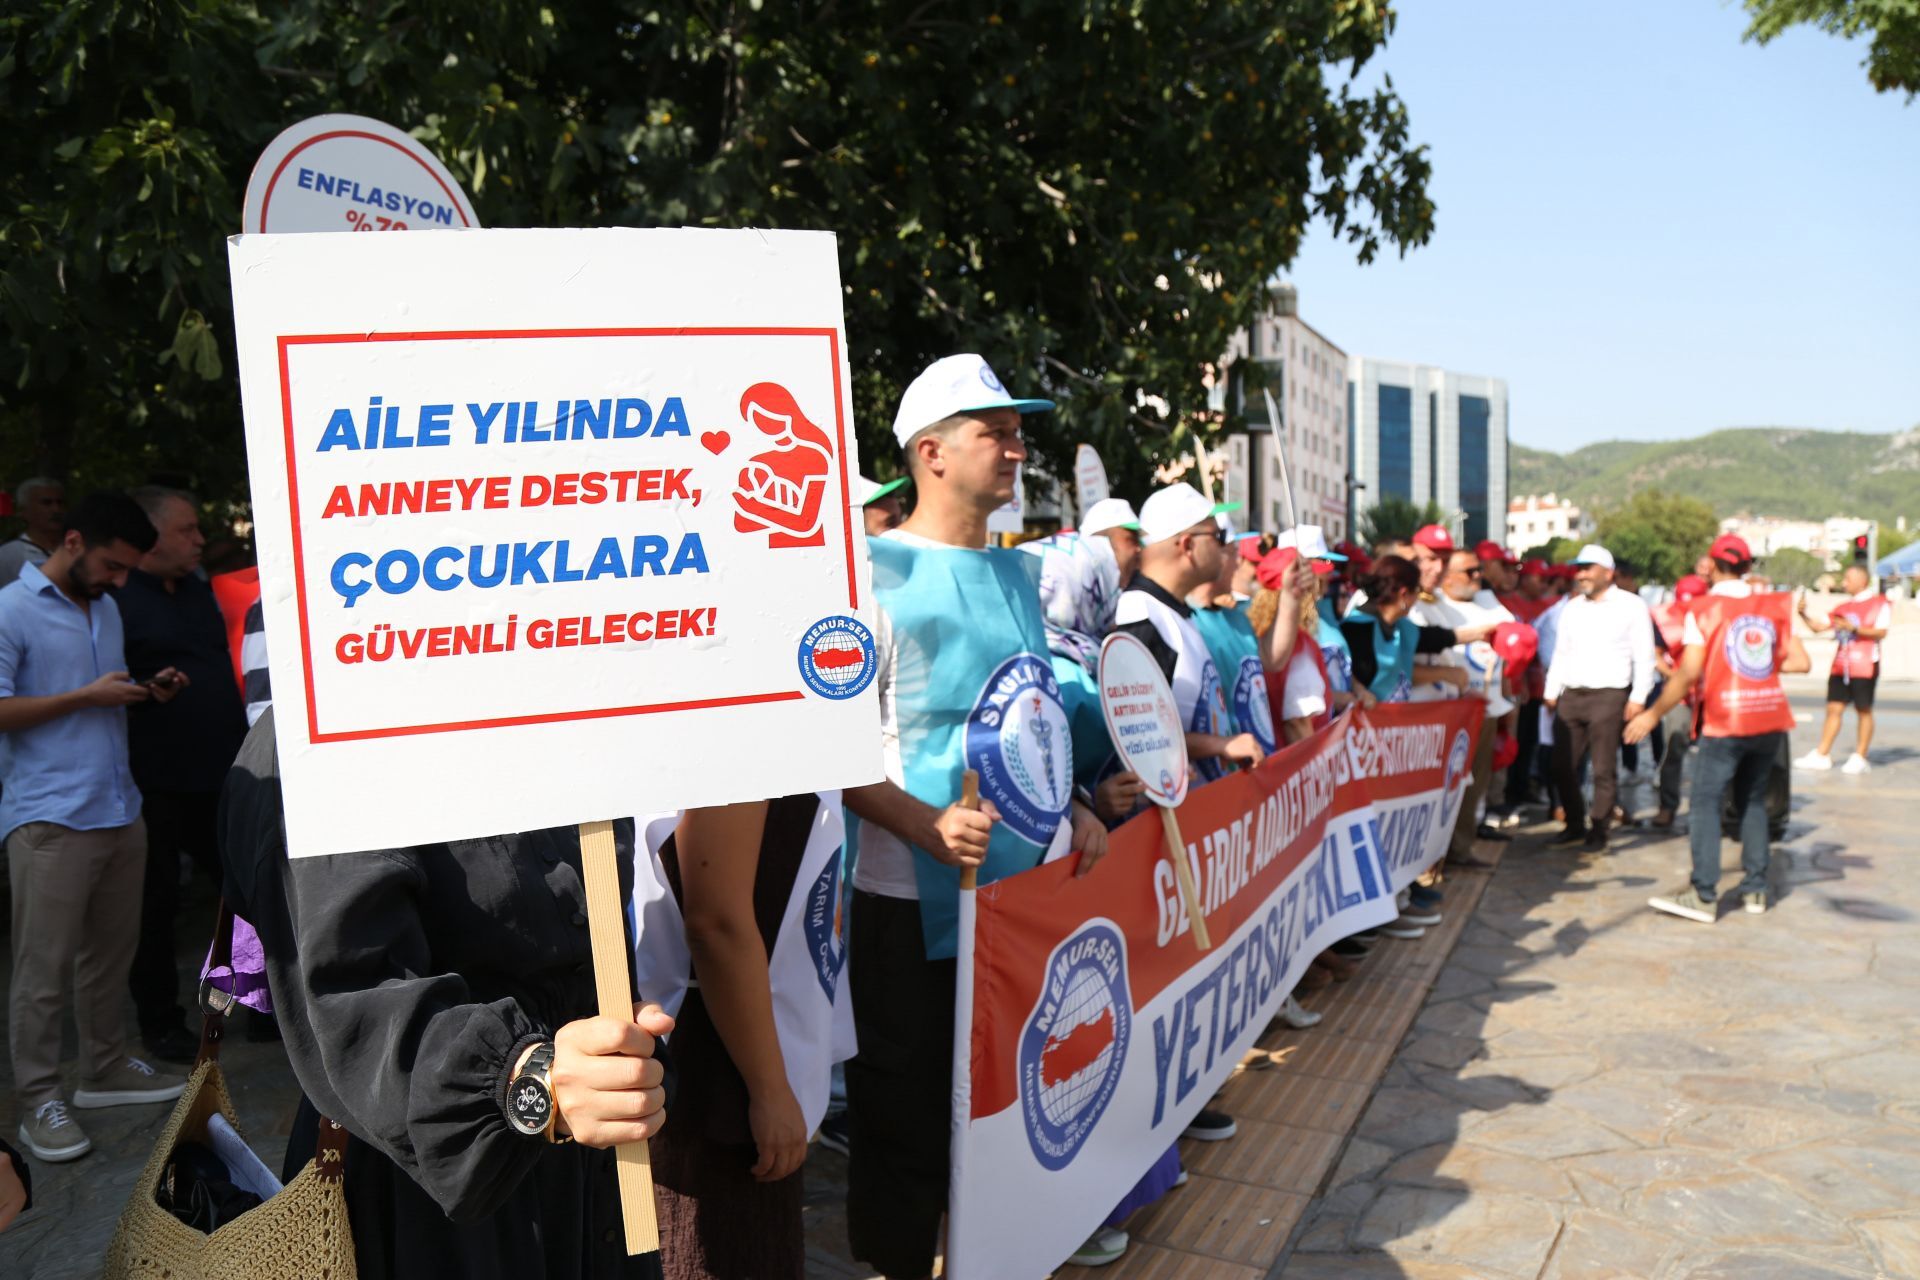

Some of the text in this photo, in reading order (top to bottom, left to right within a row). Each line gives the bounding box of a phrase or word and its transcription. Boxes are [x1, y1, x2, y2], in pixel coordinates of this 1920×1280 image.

[297, 167, 453, 226] ENFLASYON
[315, 395, 692, 453] AİLE YILINDA
[321, 468, 702, 520] ANNEYE DESTEK,
[329, 532, 711, 608] ÇOCUKLARA
[334, 607, 718, 665] GÜVENLİ GELECEK!
[804, 619, 870, 647] MEMUR-SEN
[996, 787, 1009, 803] VE
[1005, 799, 1036, 828] SOSYAL
[811, 870, 833, 928] TARIM
[1035, 937, 1120, 1033] MEMUR-SEN
[1150, 880, 1301, 1131] YETERSİZ
